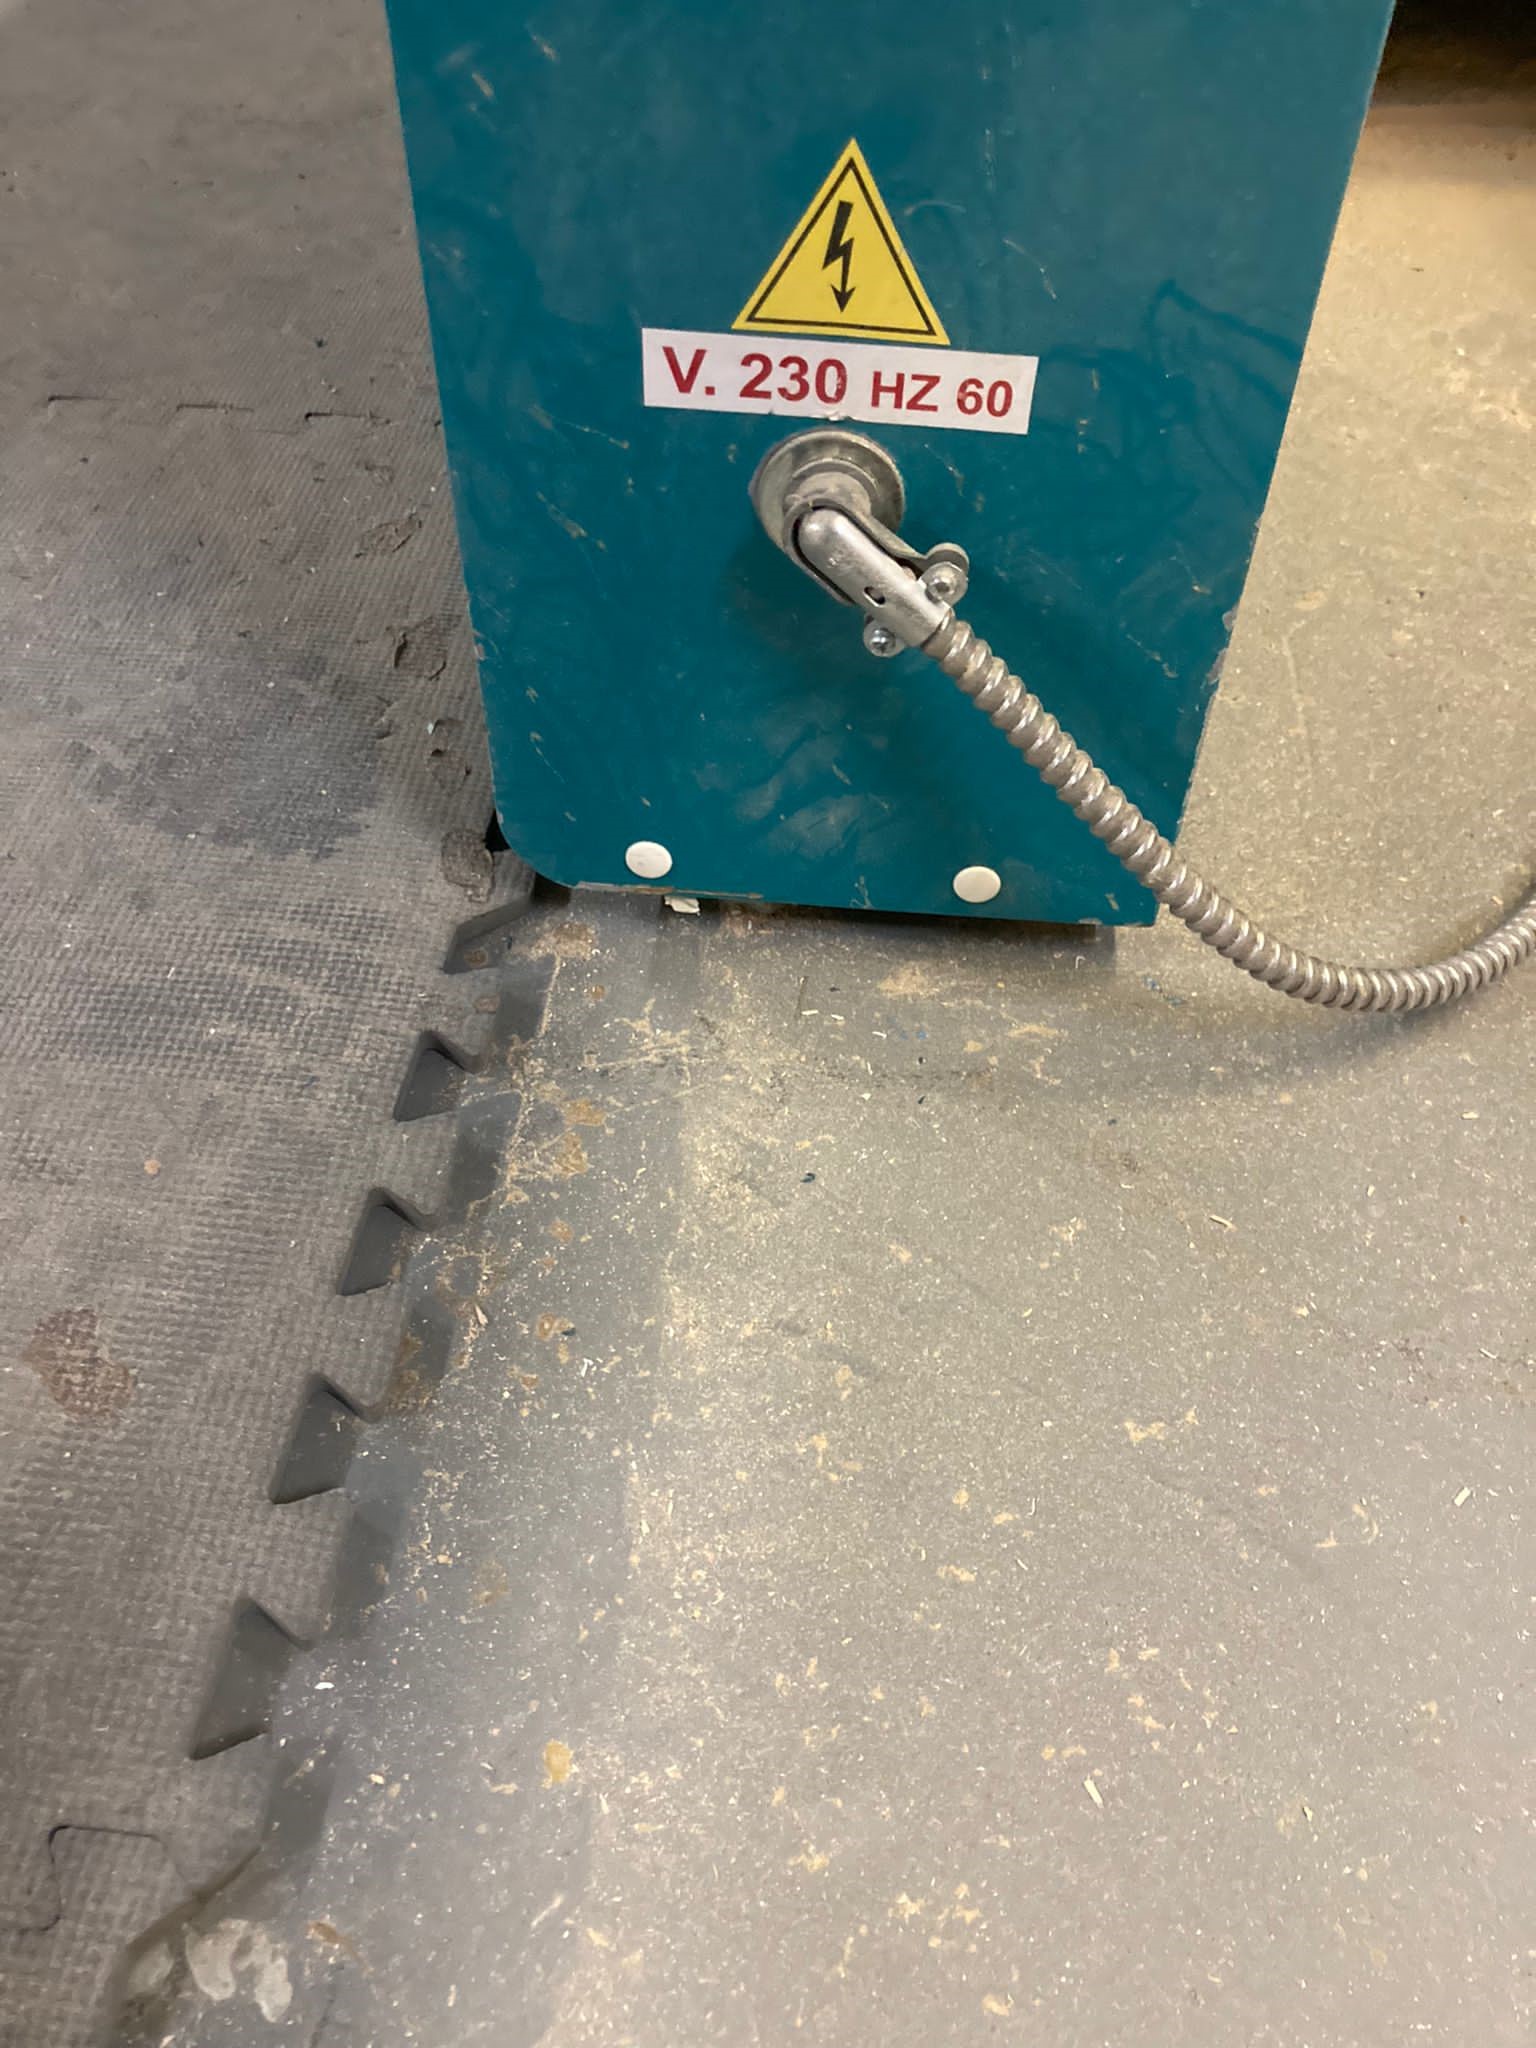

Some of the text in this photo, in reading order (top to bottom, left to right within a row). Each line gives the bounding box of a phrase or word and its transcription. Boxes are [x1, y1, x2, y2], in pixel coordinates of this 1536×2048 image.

[662, 346, 1014, 418] V. 230 HZ 60
